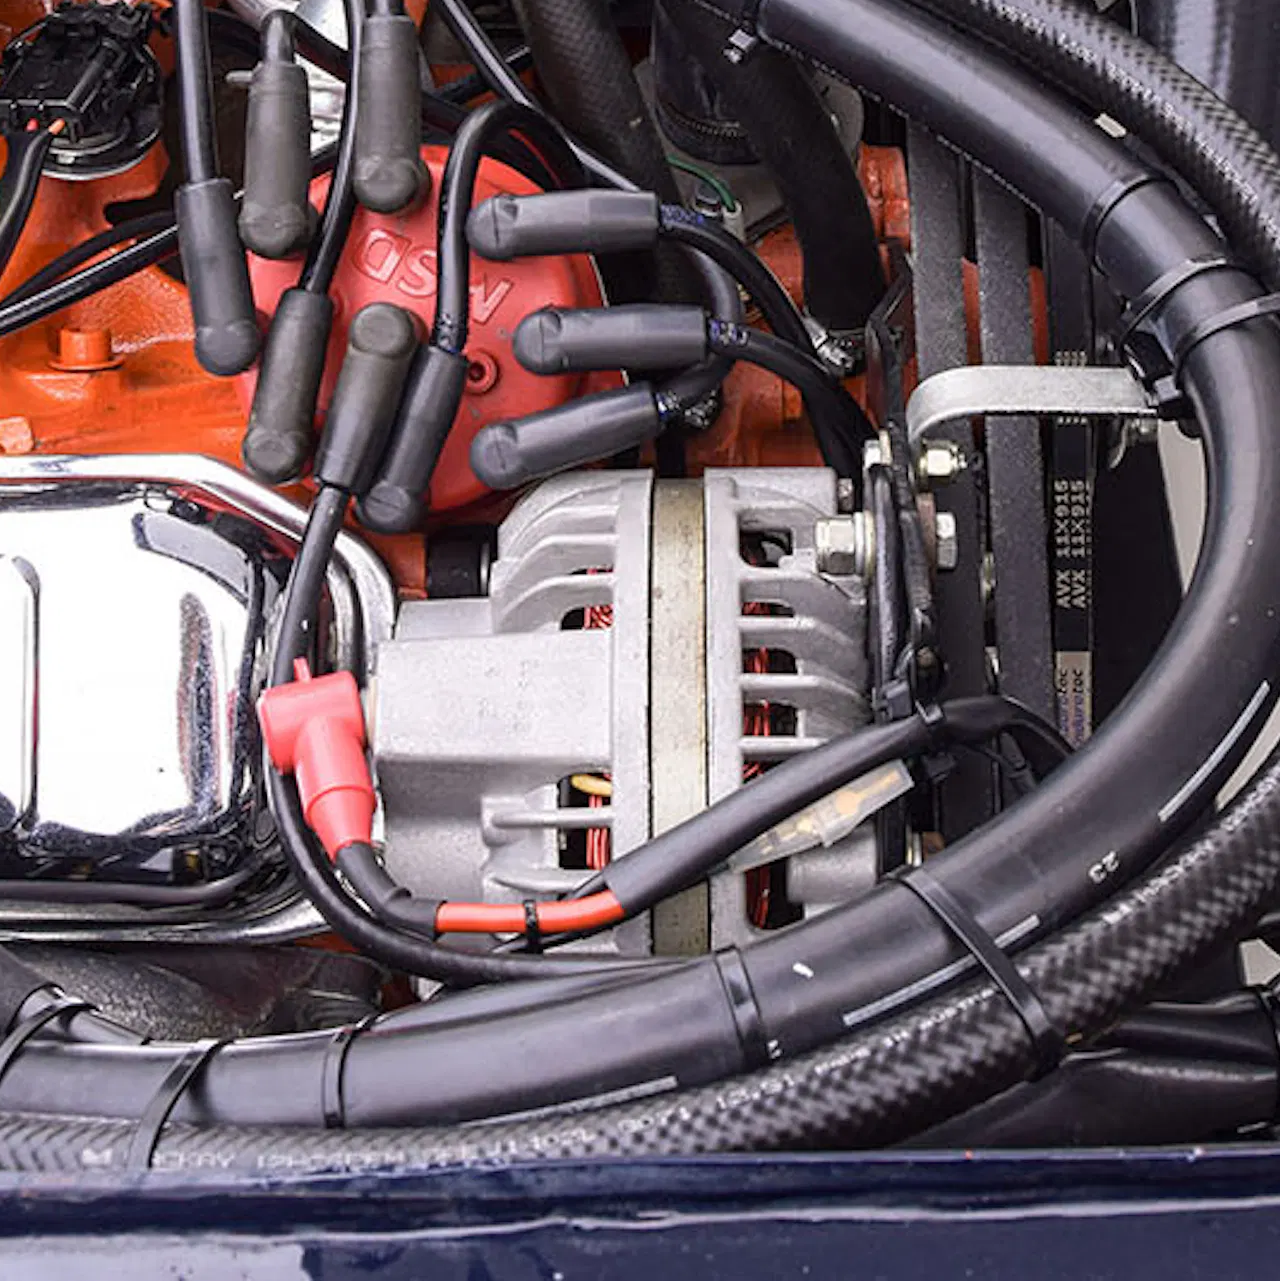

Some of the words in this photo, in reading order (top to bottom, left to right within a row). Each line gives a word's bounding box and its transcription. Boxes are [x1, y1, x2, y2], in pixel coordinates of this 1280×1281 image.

[351, 226, 516, 327] MSD
[1056, 568, 1072, 609] AVX
[1071, 568, 1087, 609] AVX
